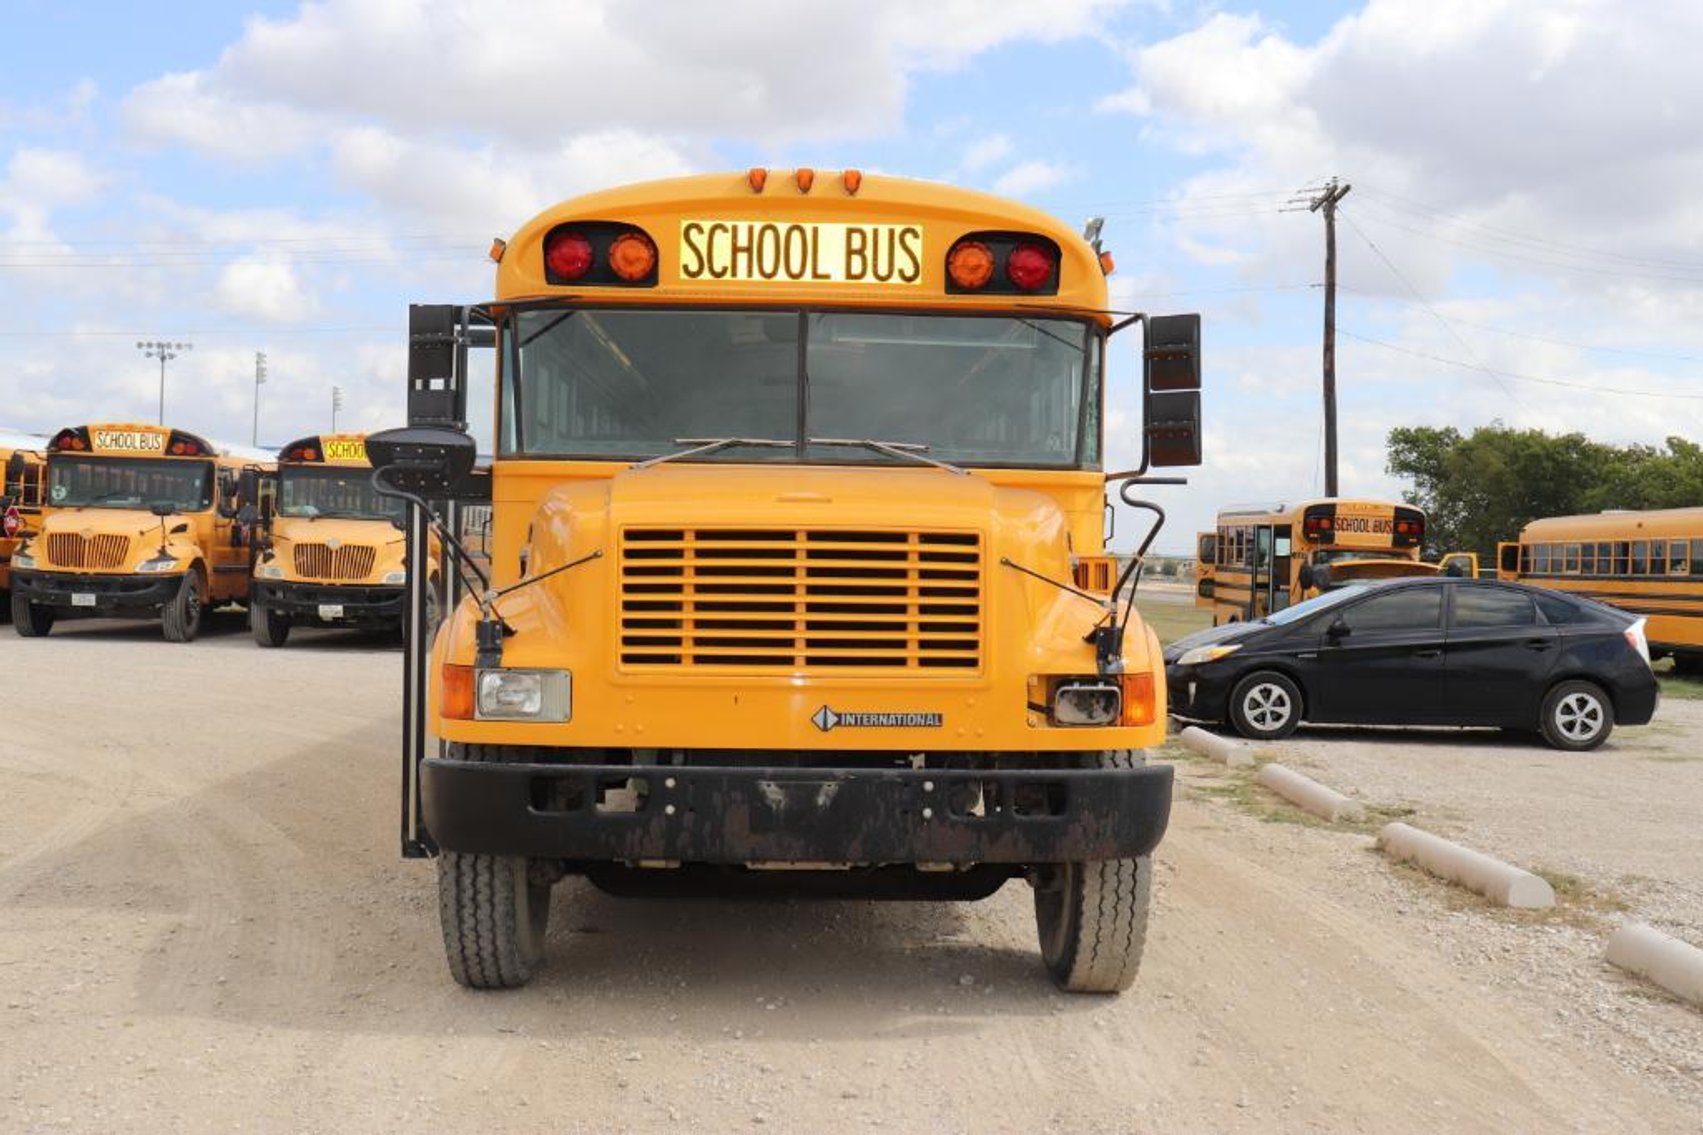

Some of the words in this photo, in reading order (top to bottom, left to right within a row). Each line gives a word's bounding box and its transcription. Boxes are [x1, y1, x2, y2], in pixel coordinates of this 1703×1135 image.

[682, 222, 831, 279] SCHOOL
[845, 226, 920, 283] BUS
[97, 431, 138, 449] SCHOOL
[140, 434, 161, 450] BUS
[329, 441, 367, 458] SCHOO
[1335, 517, 1370, 533] SCHOOL
[1373, 520, 1393, 534] BUS
[840, 713, 941, 727] INTERNATIONAL
